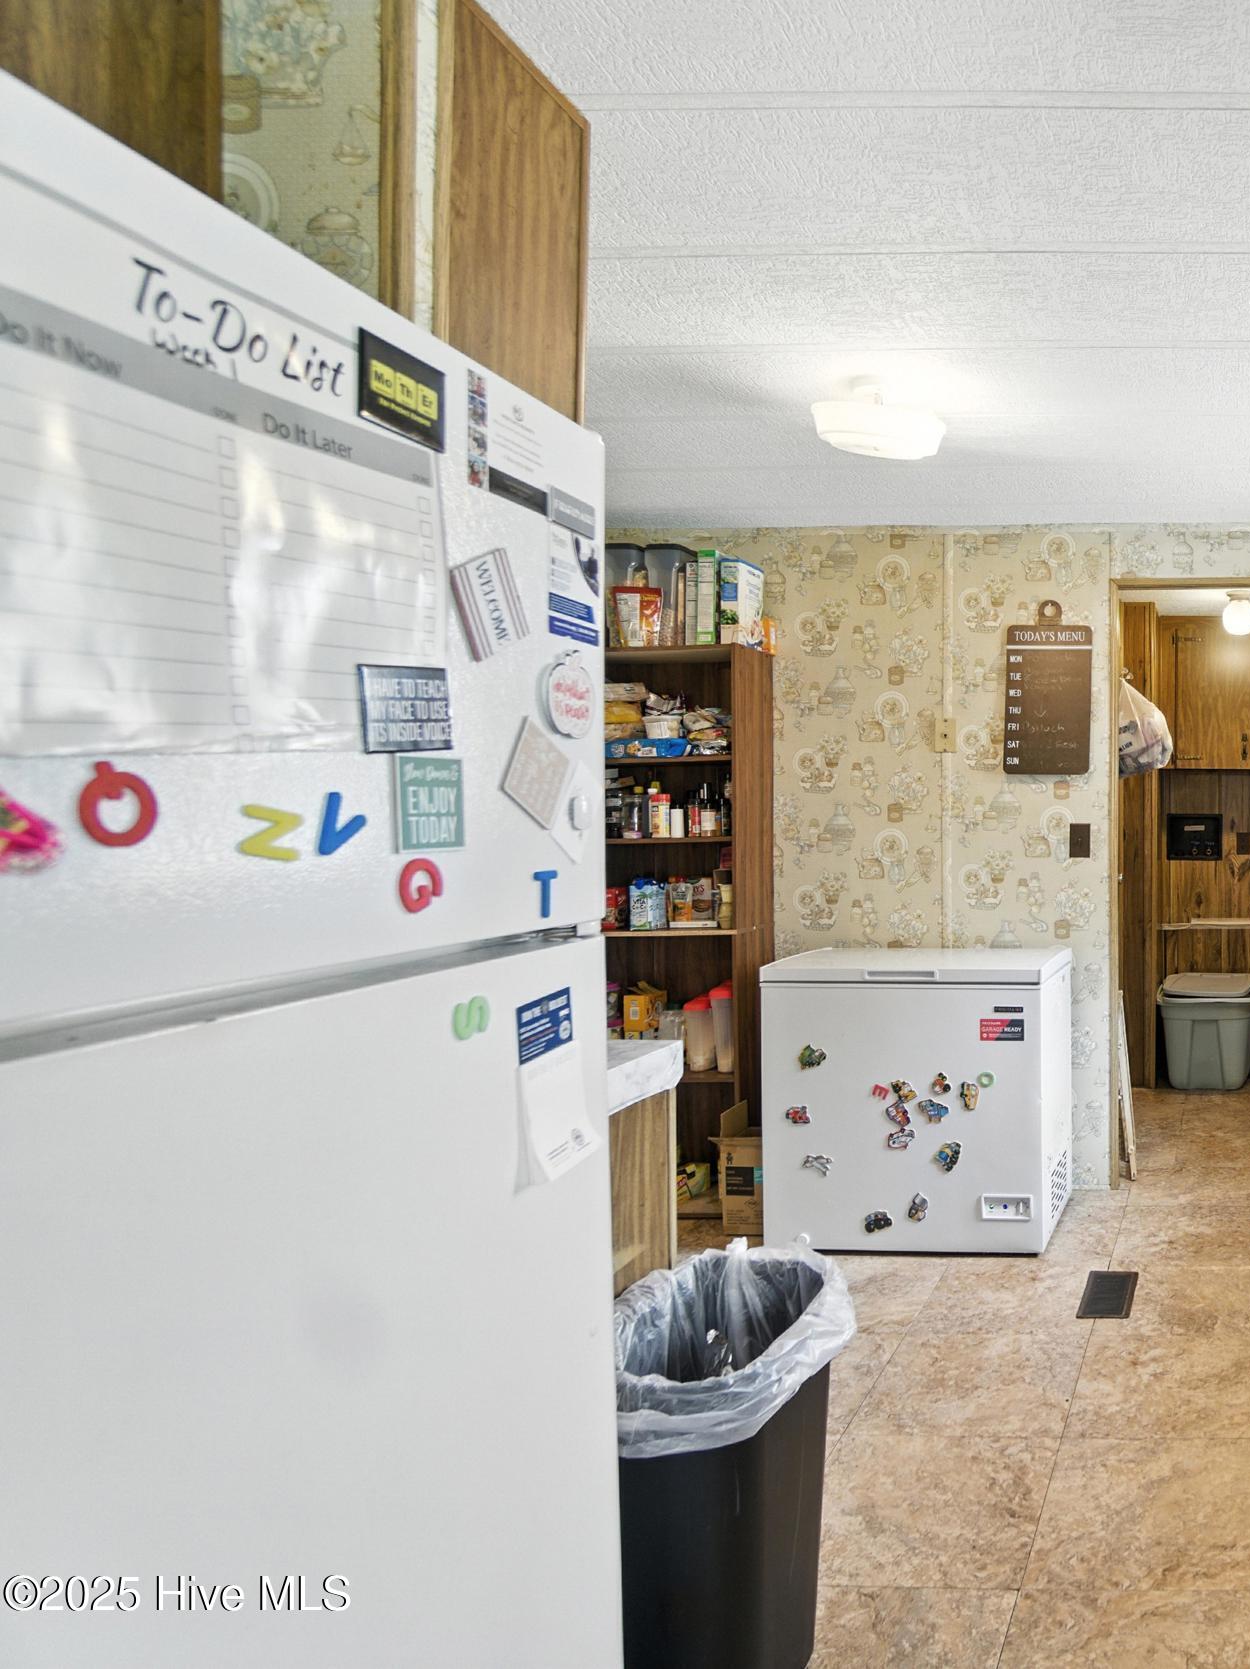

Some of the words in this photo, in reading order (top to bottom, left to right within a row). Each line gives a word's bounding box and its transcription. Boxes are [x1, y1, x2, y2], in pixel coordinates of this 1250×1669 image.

[131, 257, 269, 364] To-Do
[281, 333, 345, 397] List
[63, 334, 122, 378] Now
[262, 412, 291, 440] Do
[294, 423, 307, 446] It
[312, 429, 353, 459] Later
[1014, 631, 1056, 642] TODAY'S
[1056, 632, 1085, 642] MENU
[1009, 655, 1022, 663] MON
[1009, 672, 1022, 681] TUE
[401, 679, 415, 698] TO
[416, 679, 449, 698] TEACH
[1008, 689, 1022, 697] WED
[388, 700, 415, 720] FACE
[416, 700, 429, 720] TO
[429, 700, 449, 720] USE
[1008, 706, 1021, 714] THU
[388, 722, 423, 741] INSIDE
[424, 722, 452, 741] VOICE
[1007, 723, 1020, 731] FRI
[1007, 740, 1020, 748] SAT
[1006, 757, 1019, 765] SUN
[407, 785, 457, 815] ENJOY
[408, 816, 457, 844] TODAY
[533, 870, 558, 918] T
